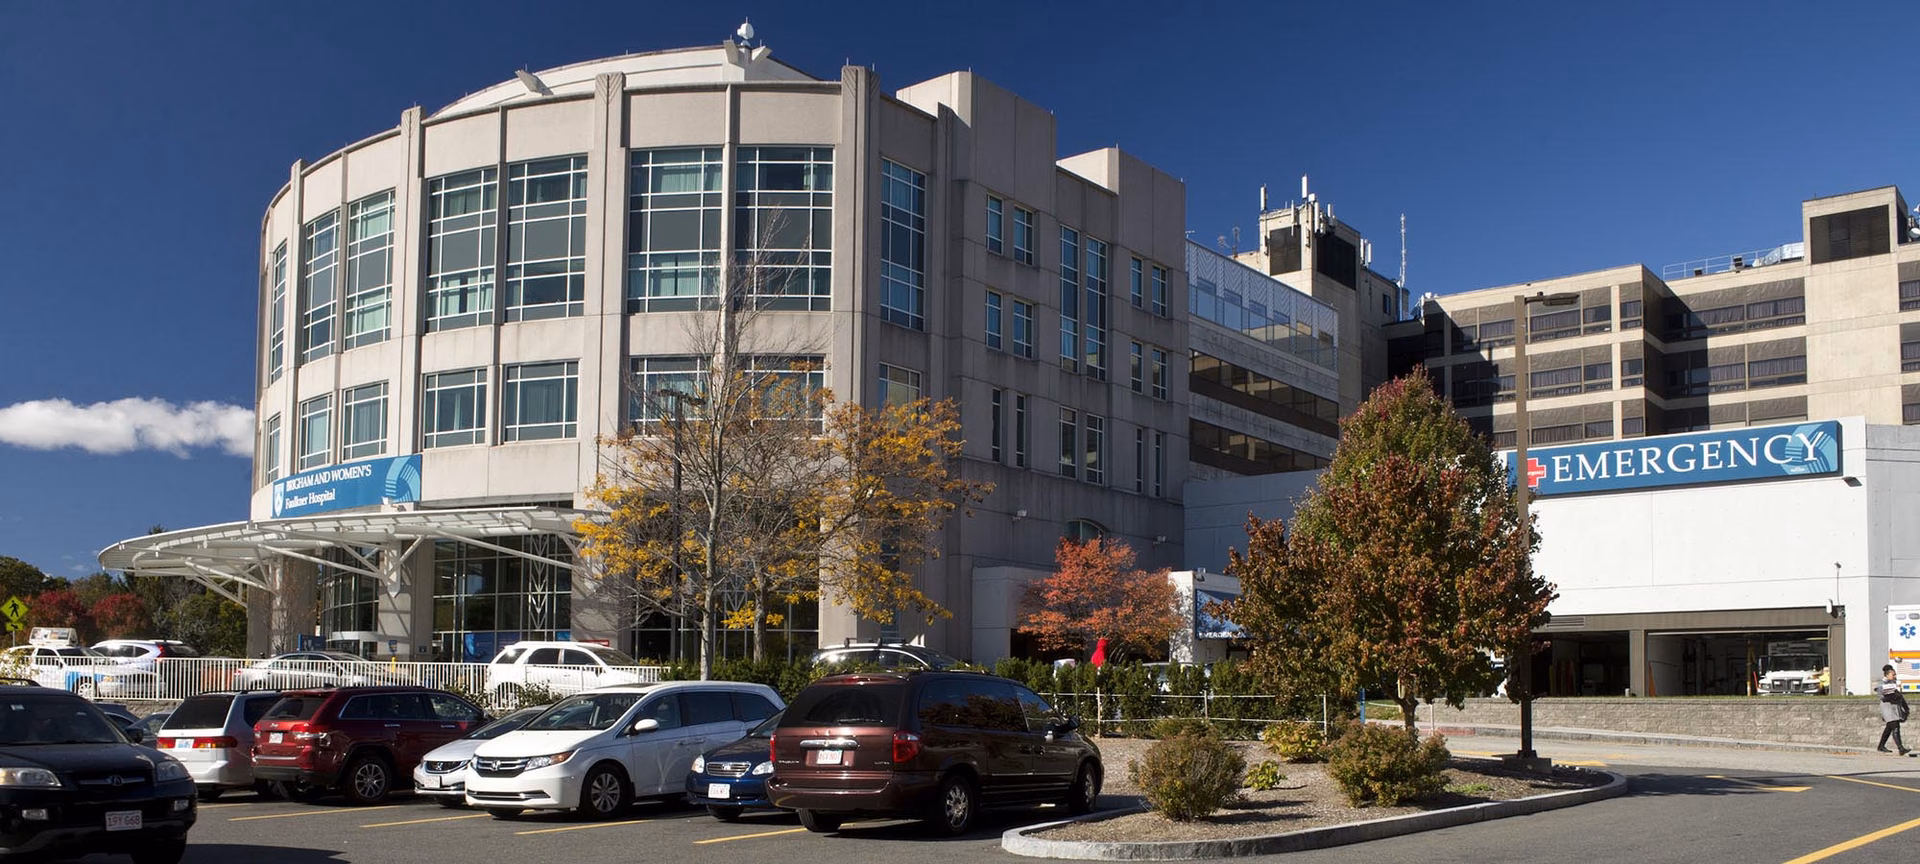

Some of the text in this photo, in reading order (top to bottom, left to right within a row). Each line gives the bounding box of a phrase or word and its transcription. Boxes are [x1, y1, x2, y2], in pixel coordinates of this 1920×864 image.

[1552, 431, 1825, 483] EMERGENCY
[286, 464, 372, 492] BRIGHAM AND WOMEN'S
[285, 488, 336, 509] Faulkner Hospital
